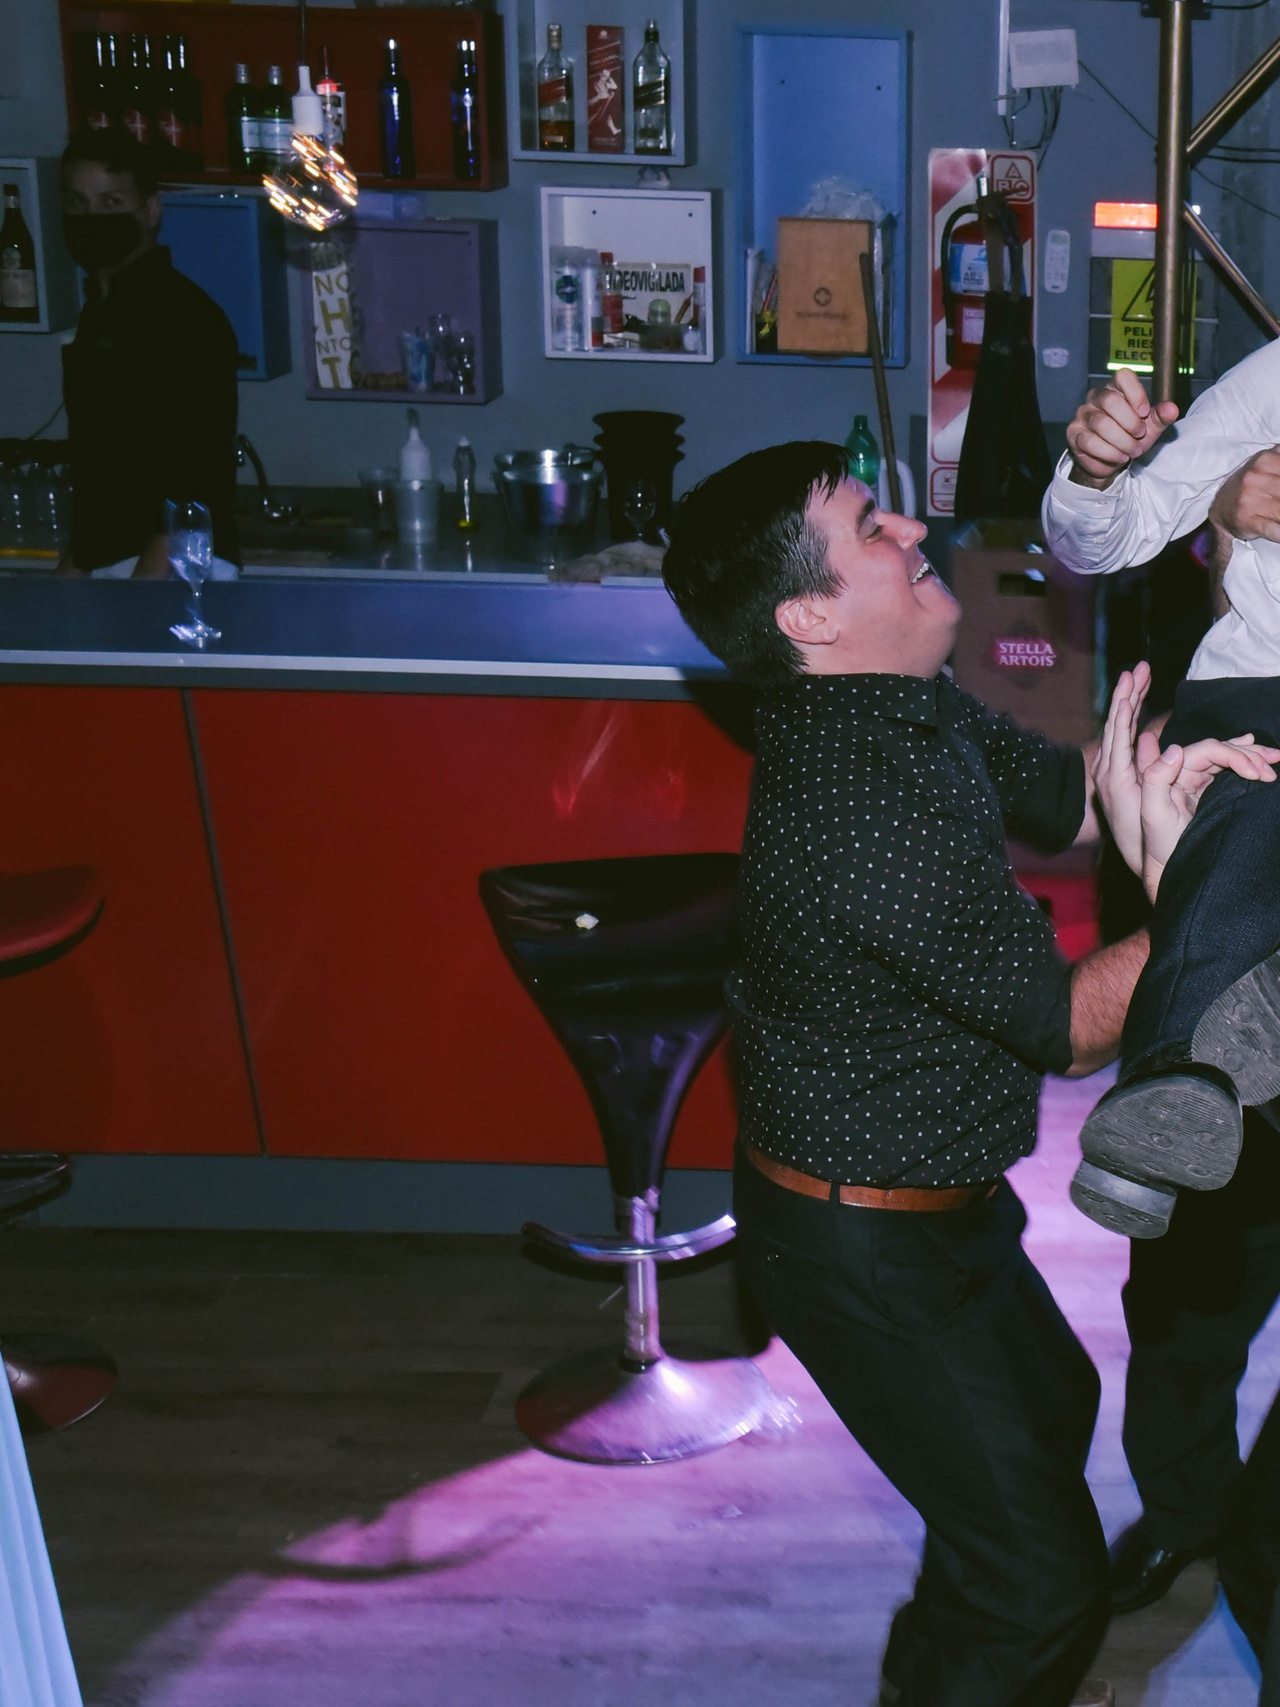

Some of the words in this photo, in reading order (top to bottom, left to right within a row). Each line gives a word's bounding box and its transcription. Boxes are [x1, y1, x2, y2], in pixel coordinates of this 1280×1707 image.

[1124, 326, 1154, 337] PELI
[1115, 350, 1154, 361] ELECT
[999, 643, 1054, 655] STELLA
[999, 655, 1054, 667] ARTOIS
